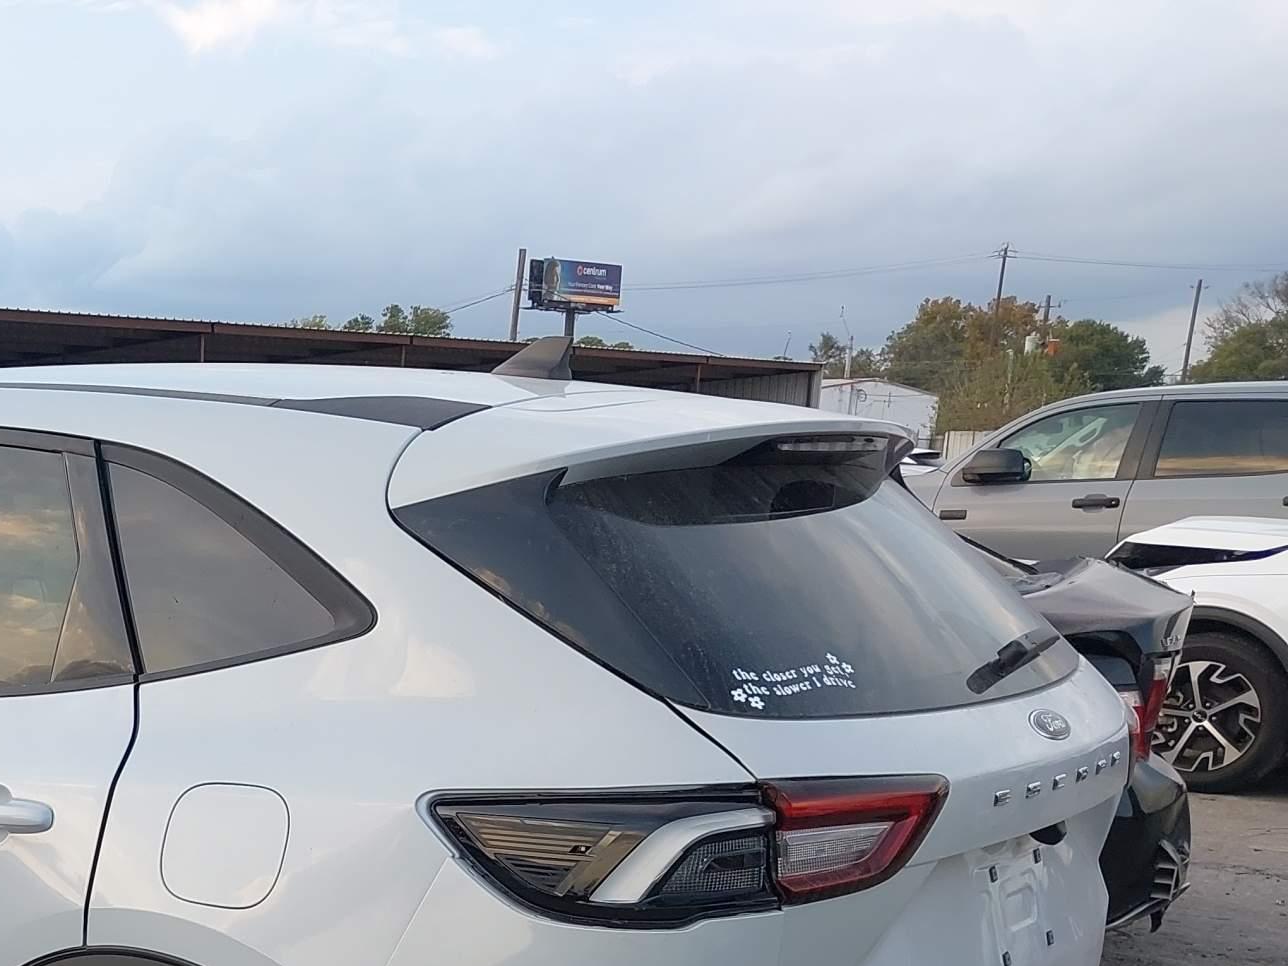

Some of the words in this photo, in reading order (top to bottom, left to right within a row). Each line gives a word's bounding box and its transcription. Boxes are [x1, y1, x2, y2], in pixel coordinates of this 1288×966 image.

[583, 266, 607, 277] centrum
[732, 668, 760, 681] the
[762, 669, 798, 682] closer
[800, 664, 822, 678] you
[743, 683, 771, 696] the
[773, 680, 813, 696] slower
[823, 674, 857, 689] drive
